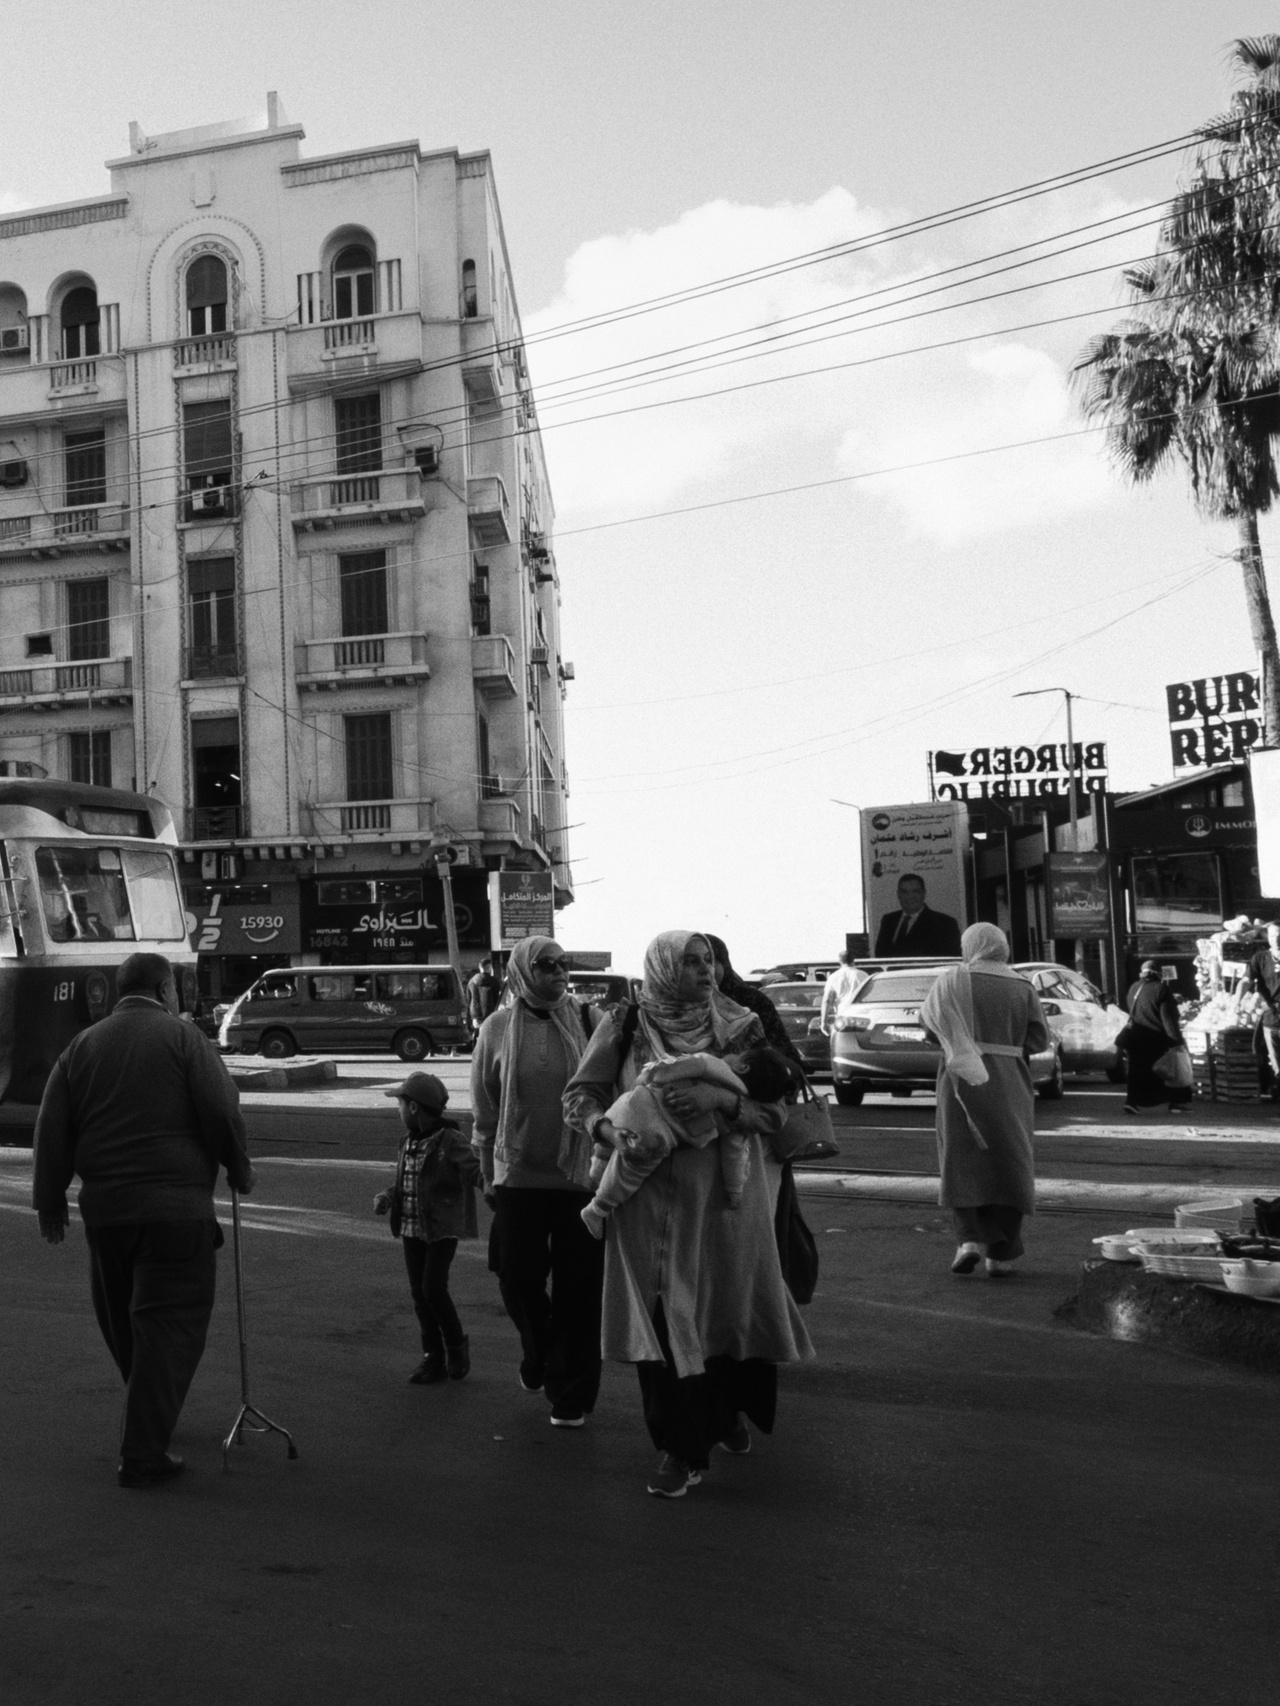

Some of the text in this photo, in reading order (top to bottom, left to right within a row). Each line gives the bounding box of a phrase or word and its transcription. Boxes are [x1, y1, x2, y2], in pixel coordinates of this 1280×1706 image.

[1166, 672, 1260, 722] BUR
[1171, 718, 1261, 768] REP
[501, 892, 552, 902] المركز المتكامل
[240, 916, 284, 929] 15930
[309, 935, 349, 948] 16842
[54, 981, 75, 1001] 181
